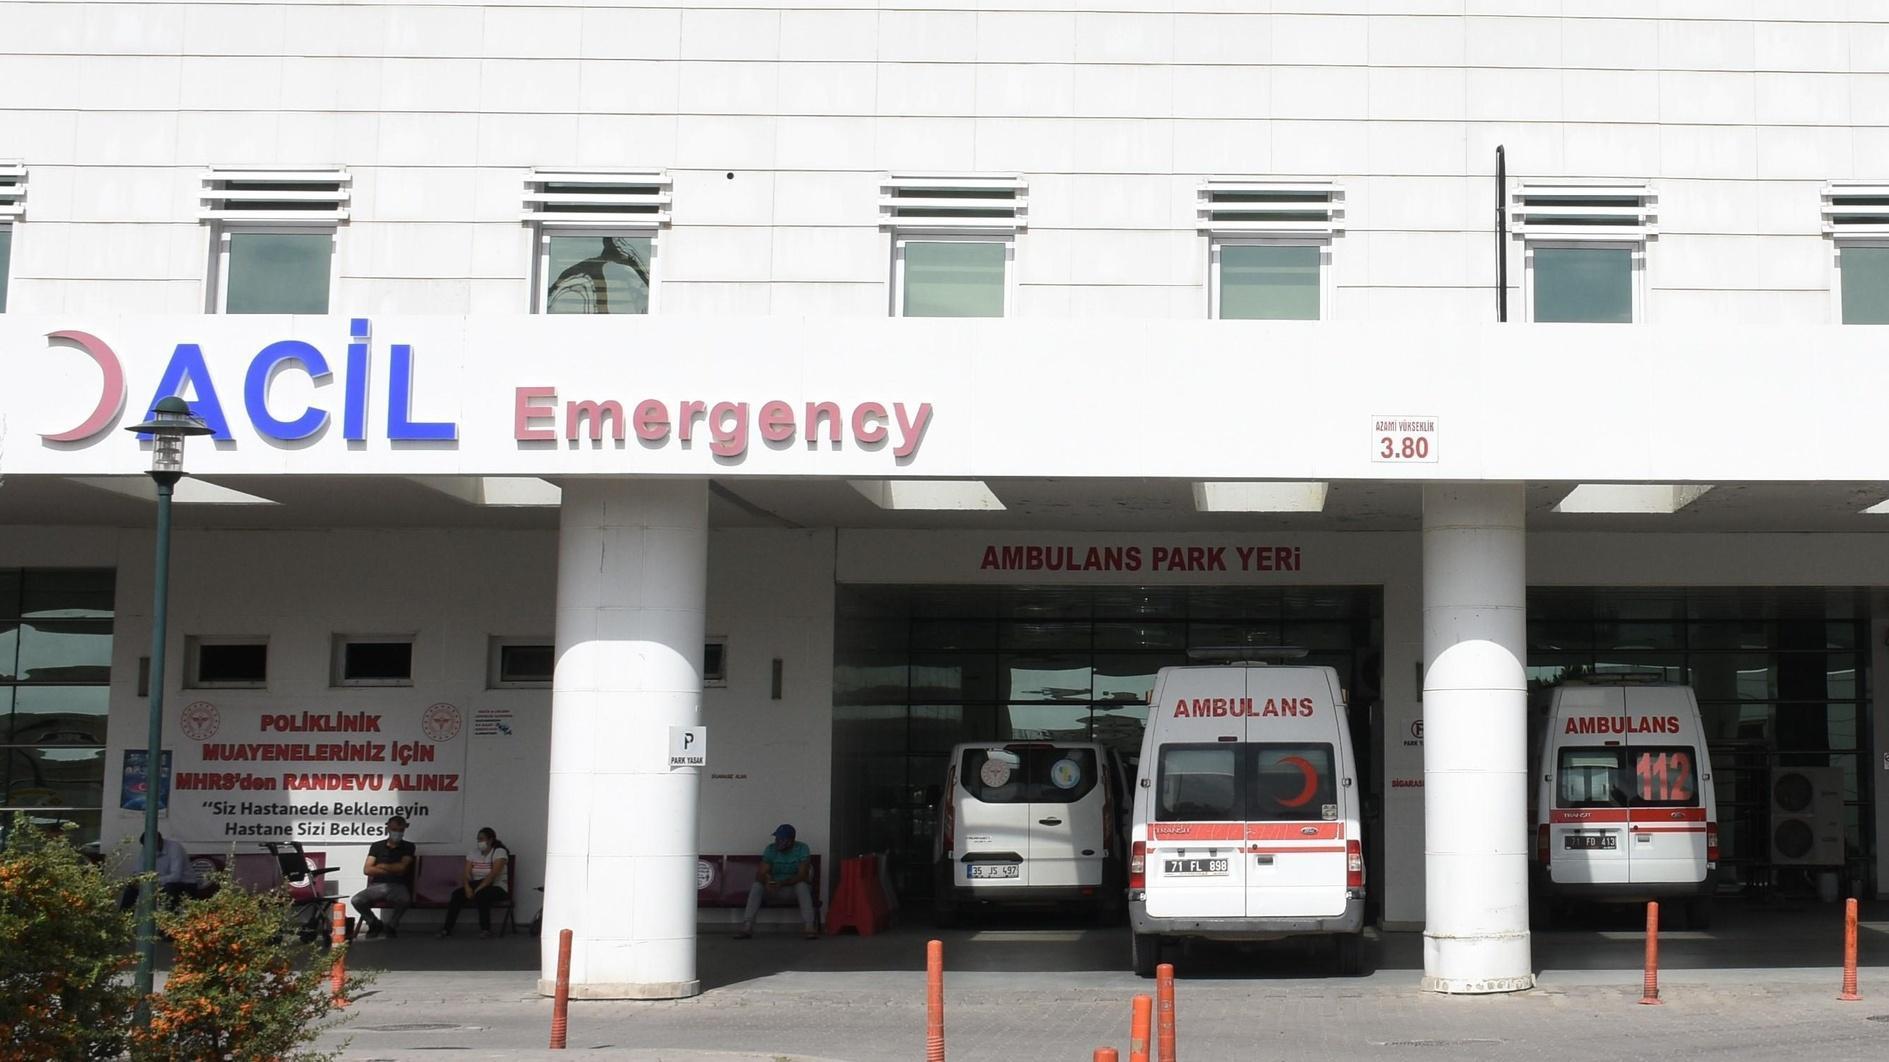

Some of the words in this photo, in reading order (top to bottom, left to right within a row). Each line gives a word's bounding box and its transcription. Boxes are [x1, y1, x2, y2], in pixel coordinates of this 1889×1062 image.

[136, 318, 458, 444] ACİL
[514, 386, 933, 460] Emergency
[1380, 436, 1429, 459] 3.80
[980, 546, 1142, 571] AMBULANS
[1152, 546, 1227, 571] PARK
[1173, 697, 1314, 718] AMBULANS
[260, 711, 381, 732] POLİKLİNİK
[1565, 716, 1680, 734] AMBULANS
[202, 740, 386, 762] MUAYENELERİNİZ
[391, 740, 435, 766] İÇİN
[671, 756, 686, 765] PARK
[687, 756, 703, 765] YASAK
[282, 773, 384, 791] RANDEVU
[388, 773, 459, 792] ALINIZ
[1636, 752, 1691, 801] 112
[241, 801, 329, 816] Hastanede
[333, 801, 429, 819] Beklemeyin
[225, 821, 293, 836] Hastane
[297, 821, 325, 836] Sizi
[1601, 837, 1615, 846] 413
[1003, 866, 1016, 875] 497
[1171, 861, 1183, 872] 71
[1190, 861, 1202, 872] FL
[1209, 861, 1227, 872] 898
